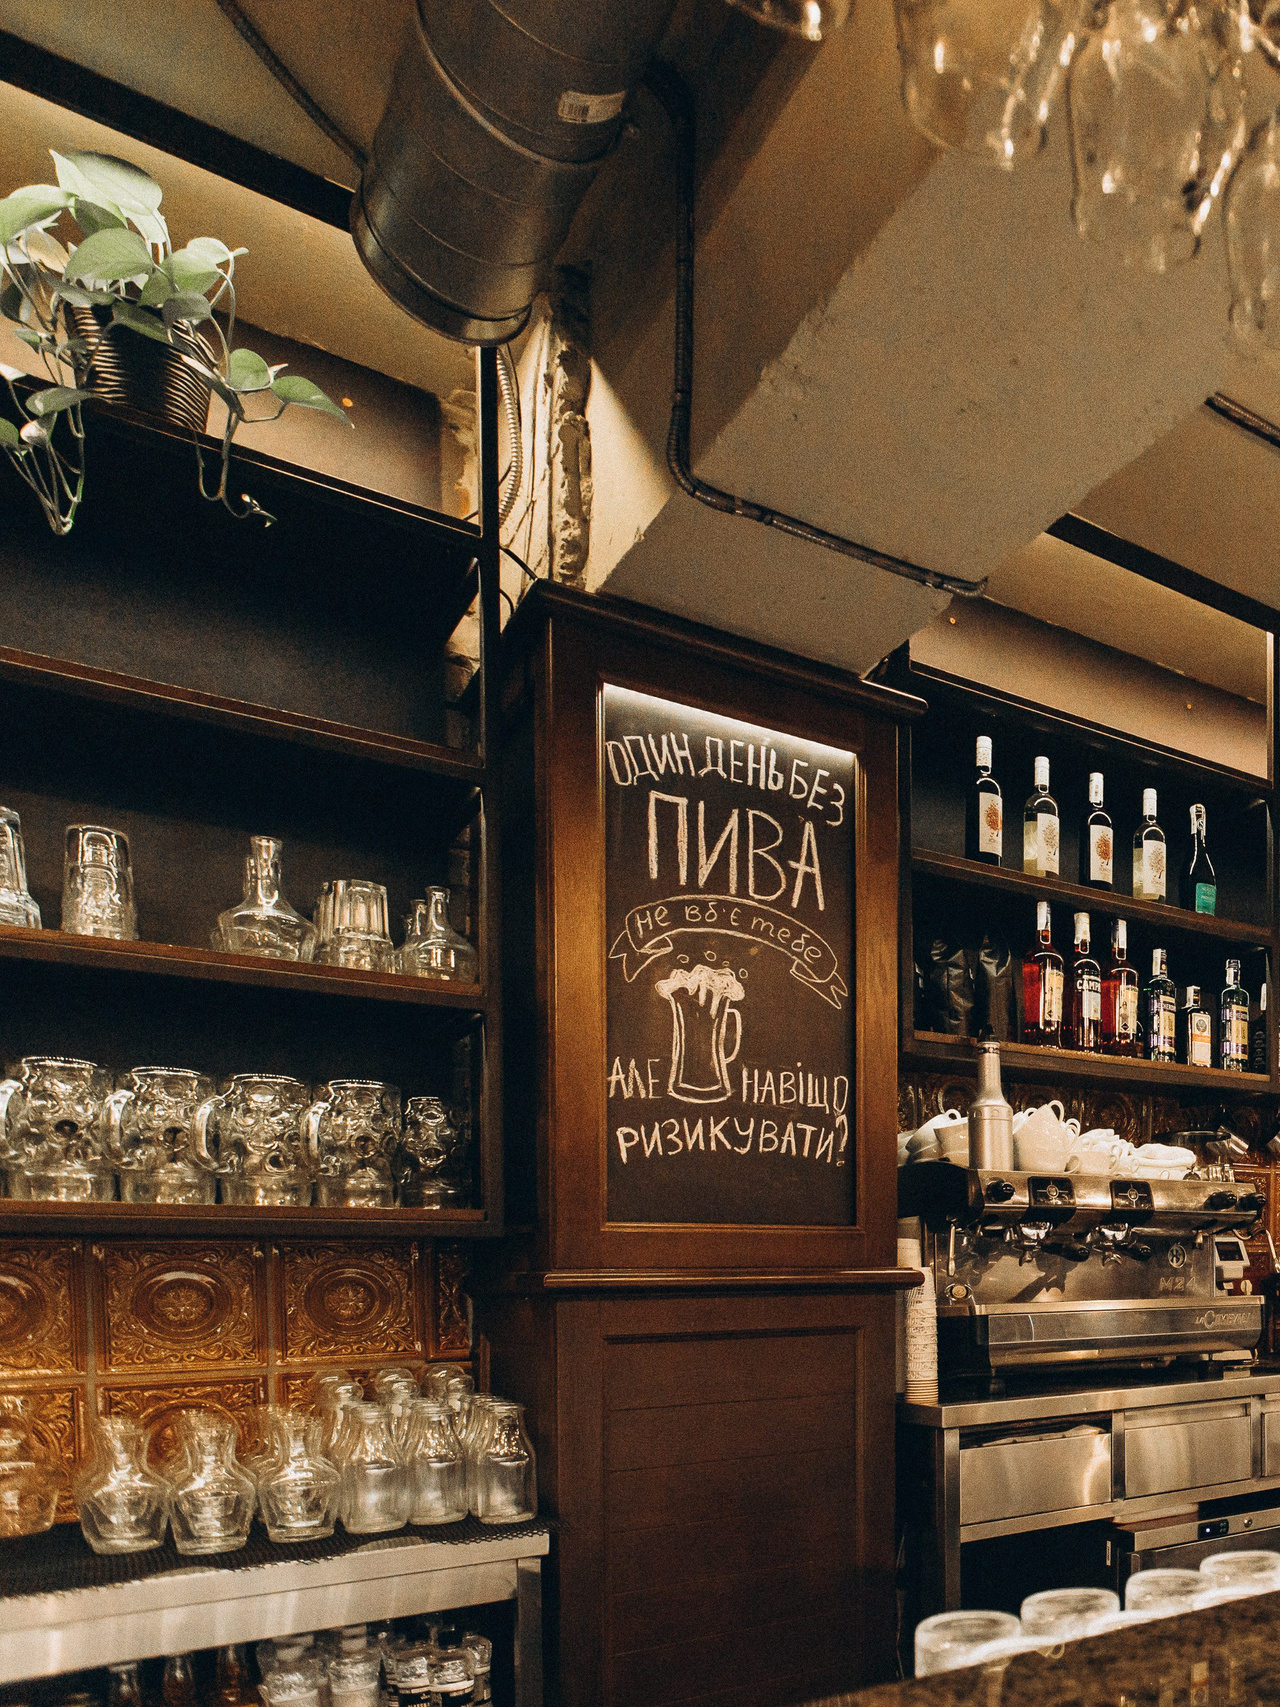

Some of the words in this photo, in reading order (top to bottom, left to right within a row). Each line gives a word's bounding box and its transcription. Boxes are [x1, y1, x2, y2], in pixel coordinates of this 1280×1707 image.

[605, 731, 696, 786] ОДИН
[698, 736, 784, 791] ДЕНЬ
[788, 758, 846, 827] БЕЗ
[648, 790, 826, 911] ПИВА
[607, 1056, 662, 1100] АЛЕ
[616, 1114, 849, 1167] РИЗИКУВАТИ?
